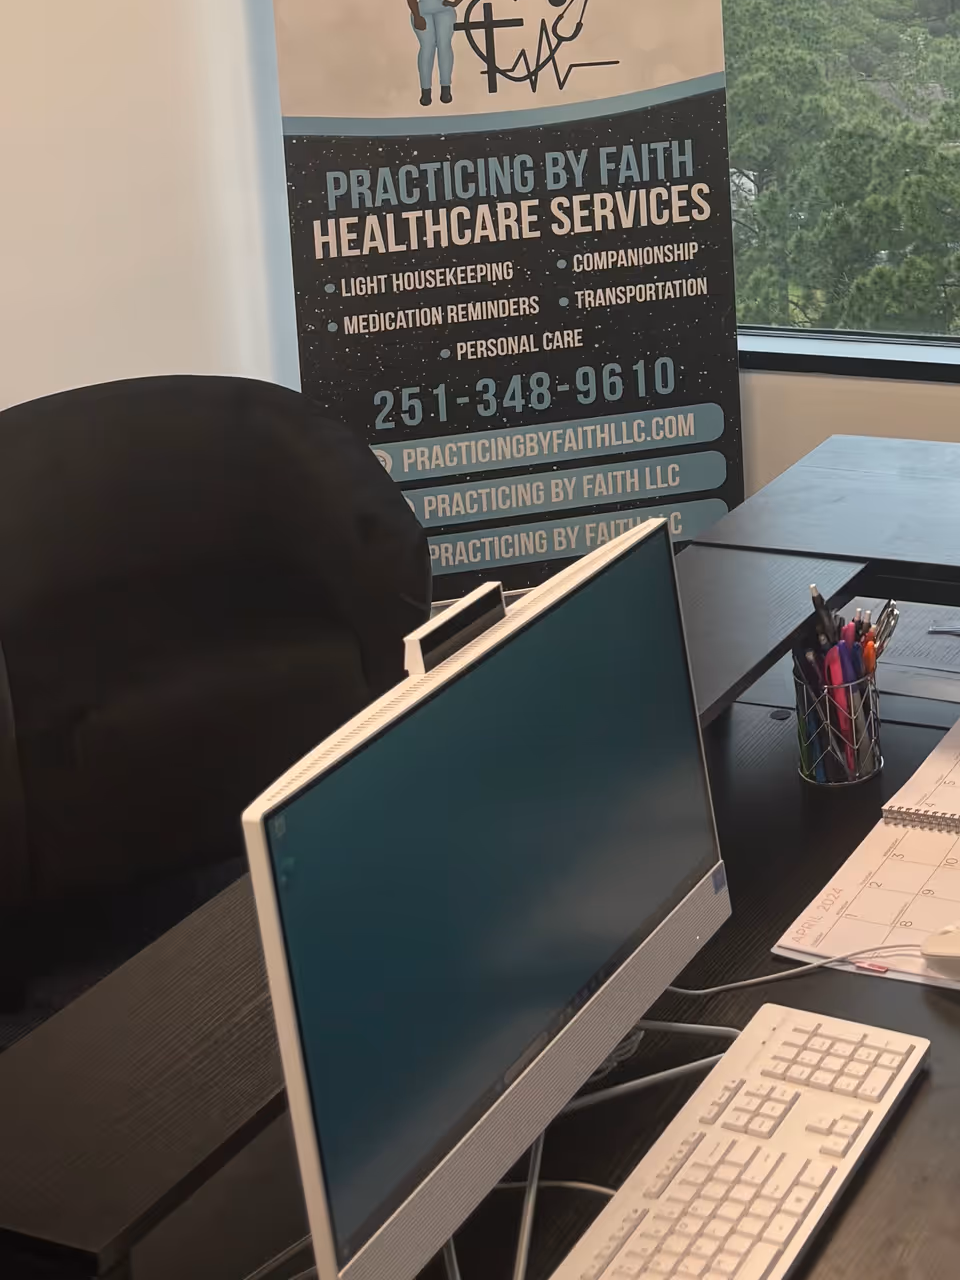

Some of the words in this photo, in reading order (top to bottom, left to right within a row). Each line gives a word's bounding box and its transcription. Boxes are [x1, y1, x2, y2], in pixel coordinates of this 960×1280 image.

[326, 154, 535, 211] PRACTICING
[545, 148, 588, 191] BY
[599, 139, 694, 186] FAITH
[312, 199, 541, 260] HEALTHCARE
[550, 183, 711, 236] SERVICES
[573, 241, 699, 272] COMPANIONSHIP
[340, 274, 387, 297] LIGHT
[391, 261, 514, 293] HOUSEKEEPING
[575, 276, 708, 309] TRANSPORTATION
[343, 306, 443, 335] MEDICATION
[447, 295, 540, 324] REMINDERS
[456, 334, 540, 361] PERSONAL
[542, 328, 584, 351] CARE
[373, 356, 675, 430] 251-348-9610
[402, 413, 695, 472] PRACTICINGBYFAITHLLC.COM
[423, 481, 545, 520] PRACTICING
[551, 476, 577, 503] BY
[582, 469, 640, 498] FAITH
[645, 463, 681, 490] LLC
[430, 530, 548, 567] PRACTICING
[553, 524, 581, 552] BY
[890, 852, 905, 860] 3
[943, 856, 960, 868] 10
[868, 880, 883, 889] 2
[922, 888, 935, 897] 9
[790, 914, 824, 945] APRIL
[816, 887, 845, 914] 2024
[845, 912, 859, 920] 1
[900, 919, 914, 928] 8
